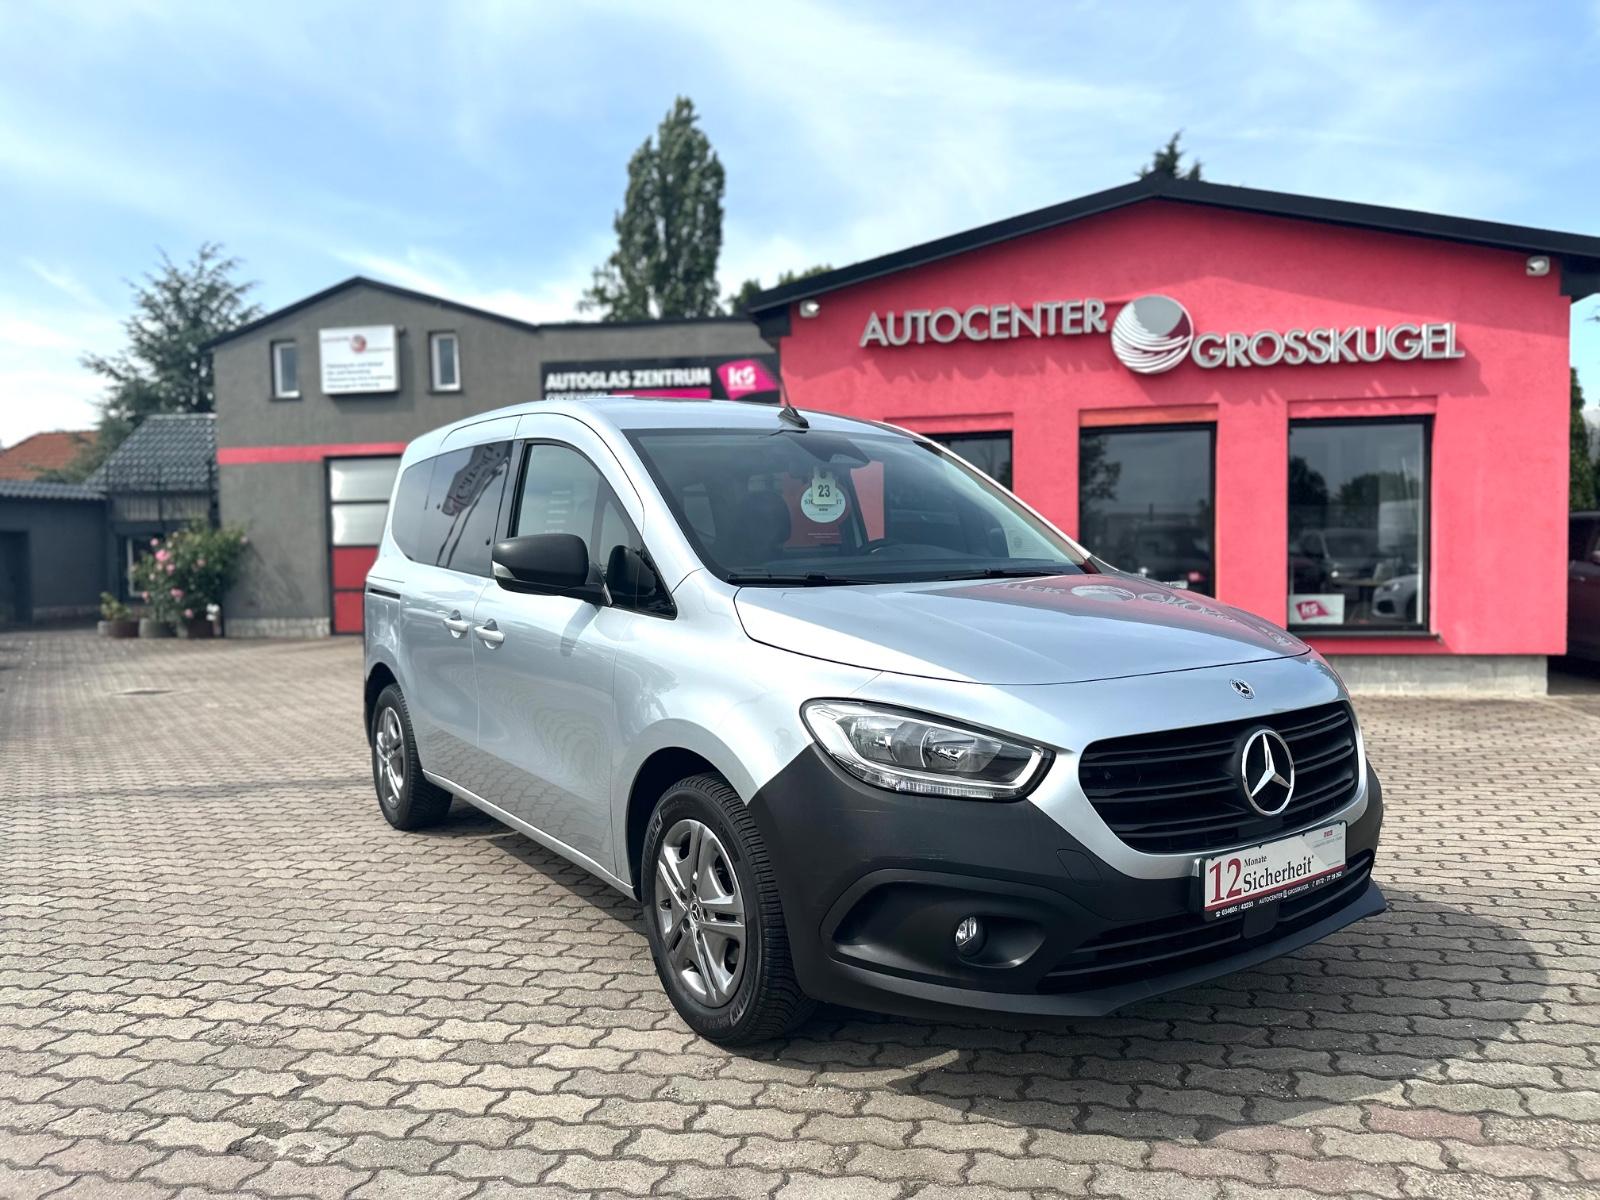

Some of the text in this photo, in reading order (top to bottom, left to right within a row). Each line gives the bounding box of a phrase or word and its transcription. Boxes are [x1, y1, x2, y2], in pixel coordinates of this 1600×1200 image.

[859, 299, 1465, 368] AUTOCENTER GROSSKUGEL
[545, 367, 711, 390] AUTOGLAS ZENTRUM
[817, 484, 830, 497] 23
[1244, 855, 1267, 868] Monate
[1209, 858, 1242, 903] 12
[1259, 892, 1283, 905] AUTOCENTER
